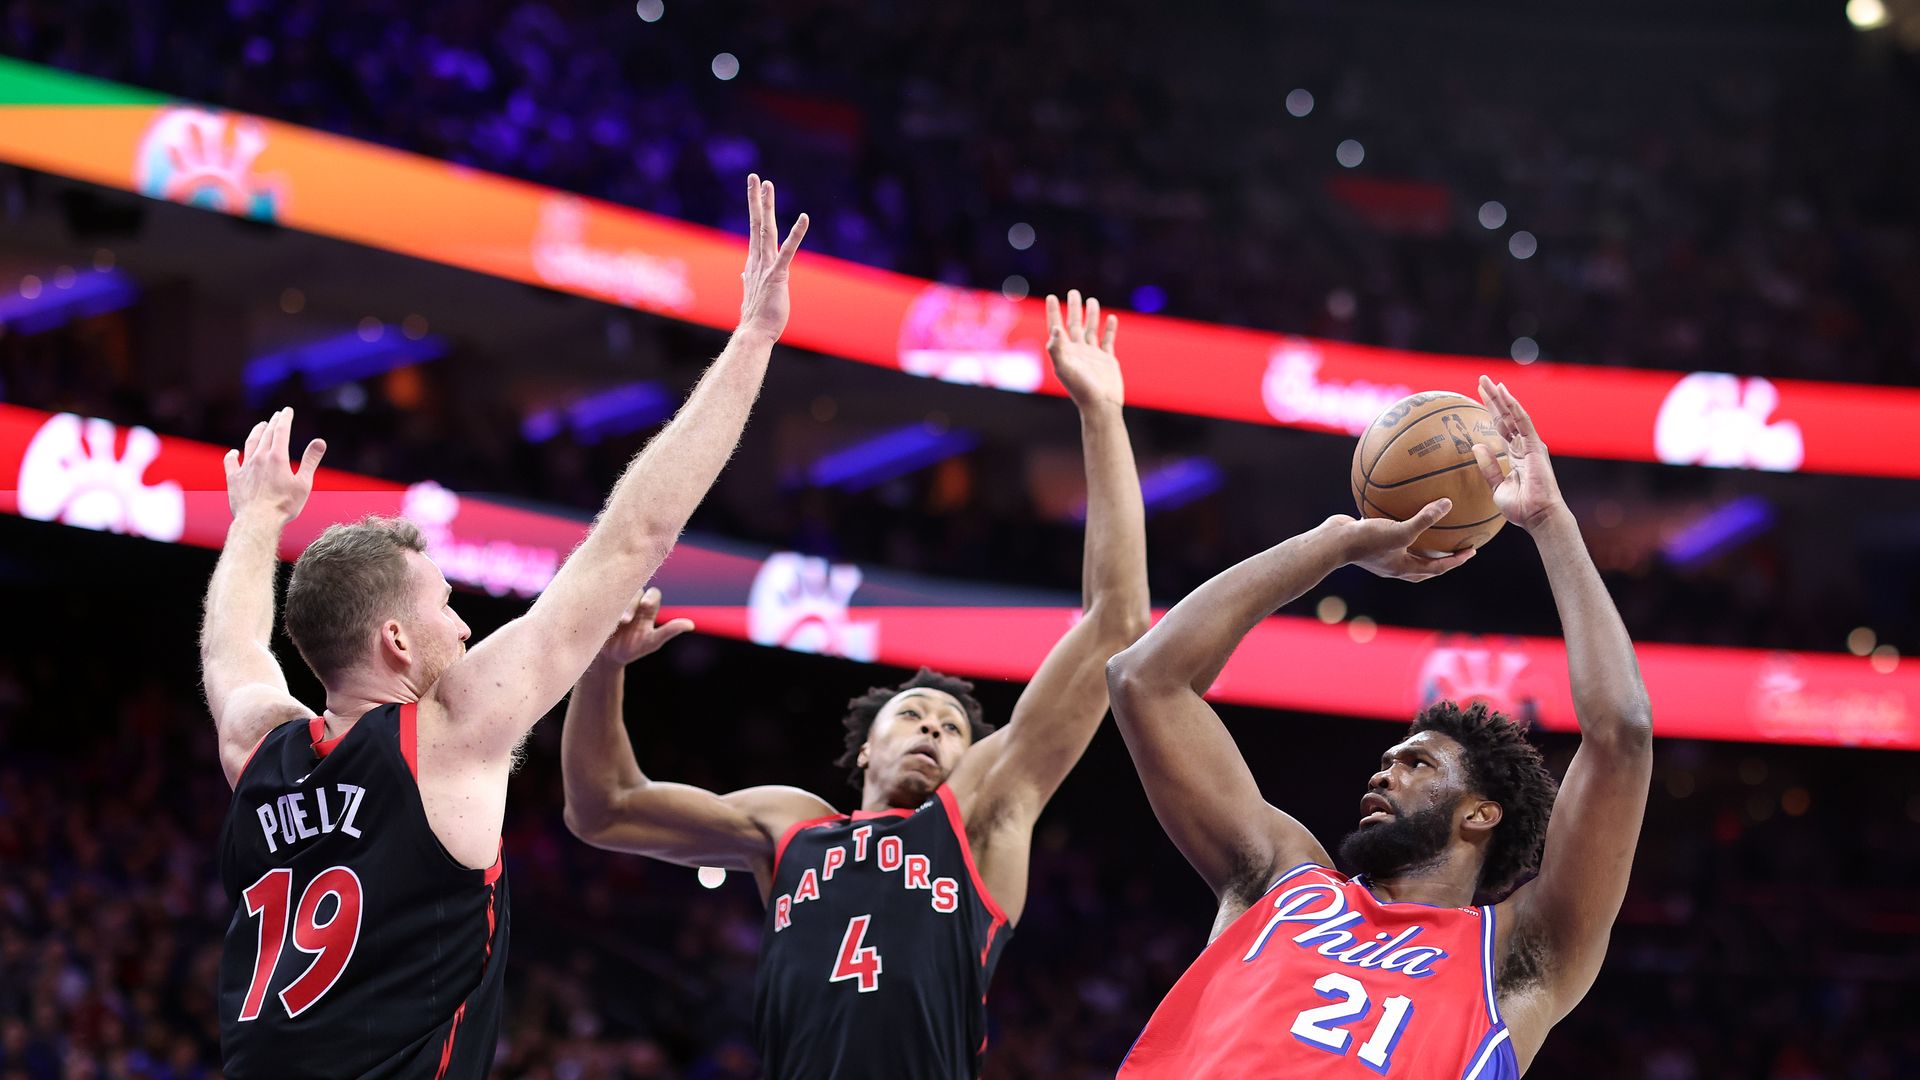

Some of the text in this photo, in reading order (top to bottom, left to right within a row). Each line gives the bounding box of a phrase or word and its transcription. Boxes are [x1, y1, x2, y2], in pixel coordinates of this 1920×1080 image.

[256, 783, 366, 853] POELTL
[775, 825, 959, 931] RAPTORS
[237, 865, 363, 1022] 19
[829, 914, 882, 993] 4
[1243, 884, 1449, 978] Phila
[1289, 972, 1414, 1075] 21
